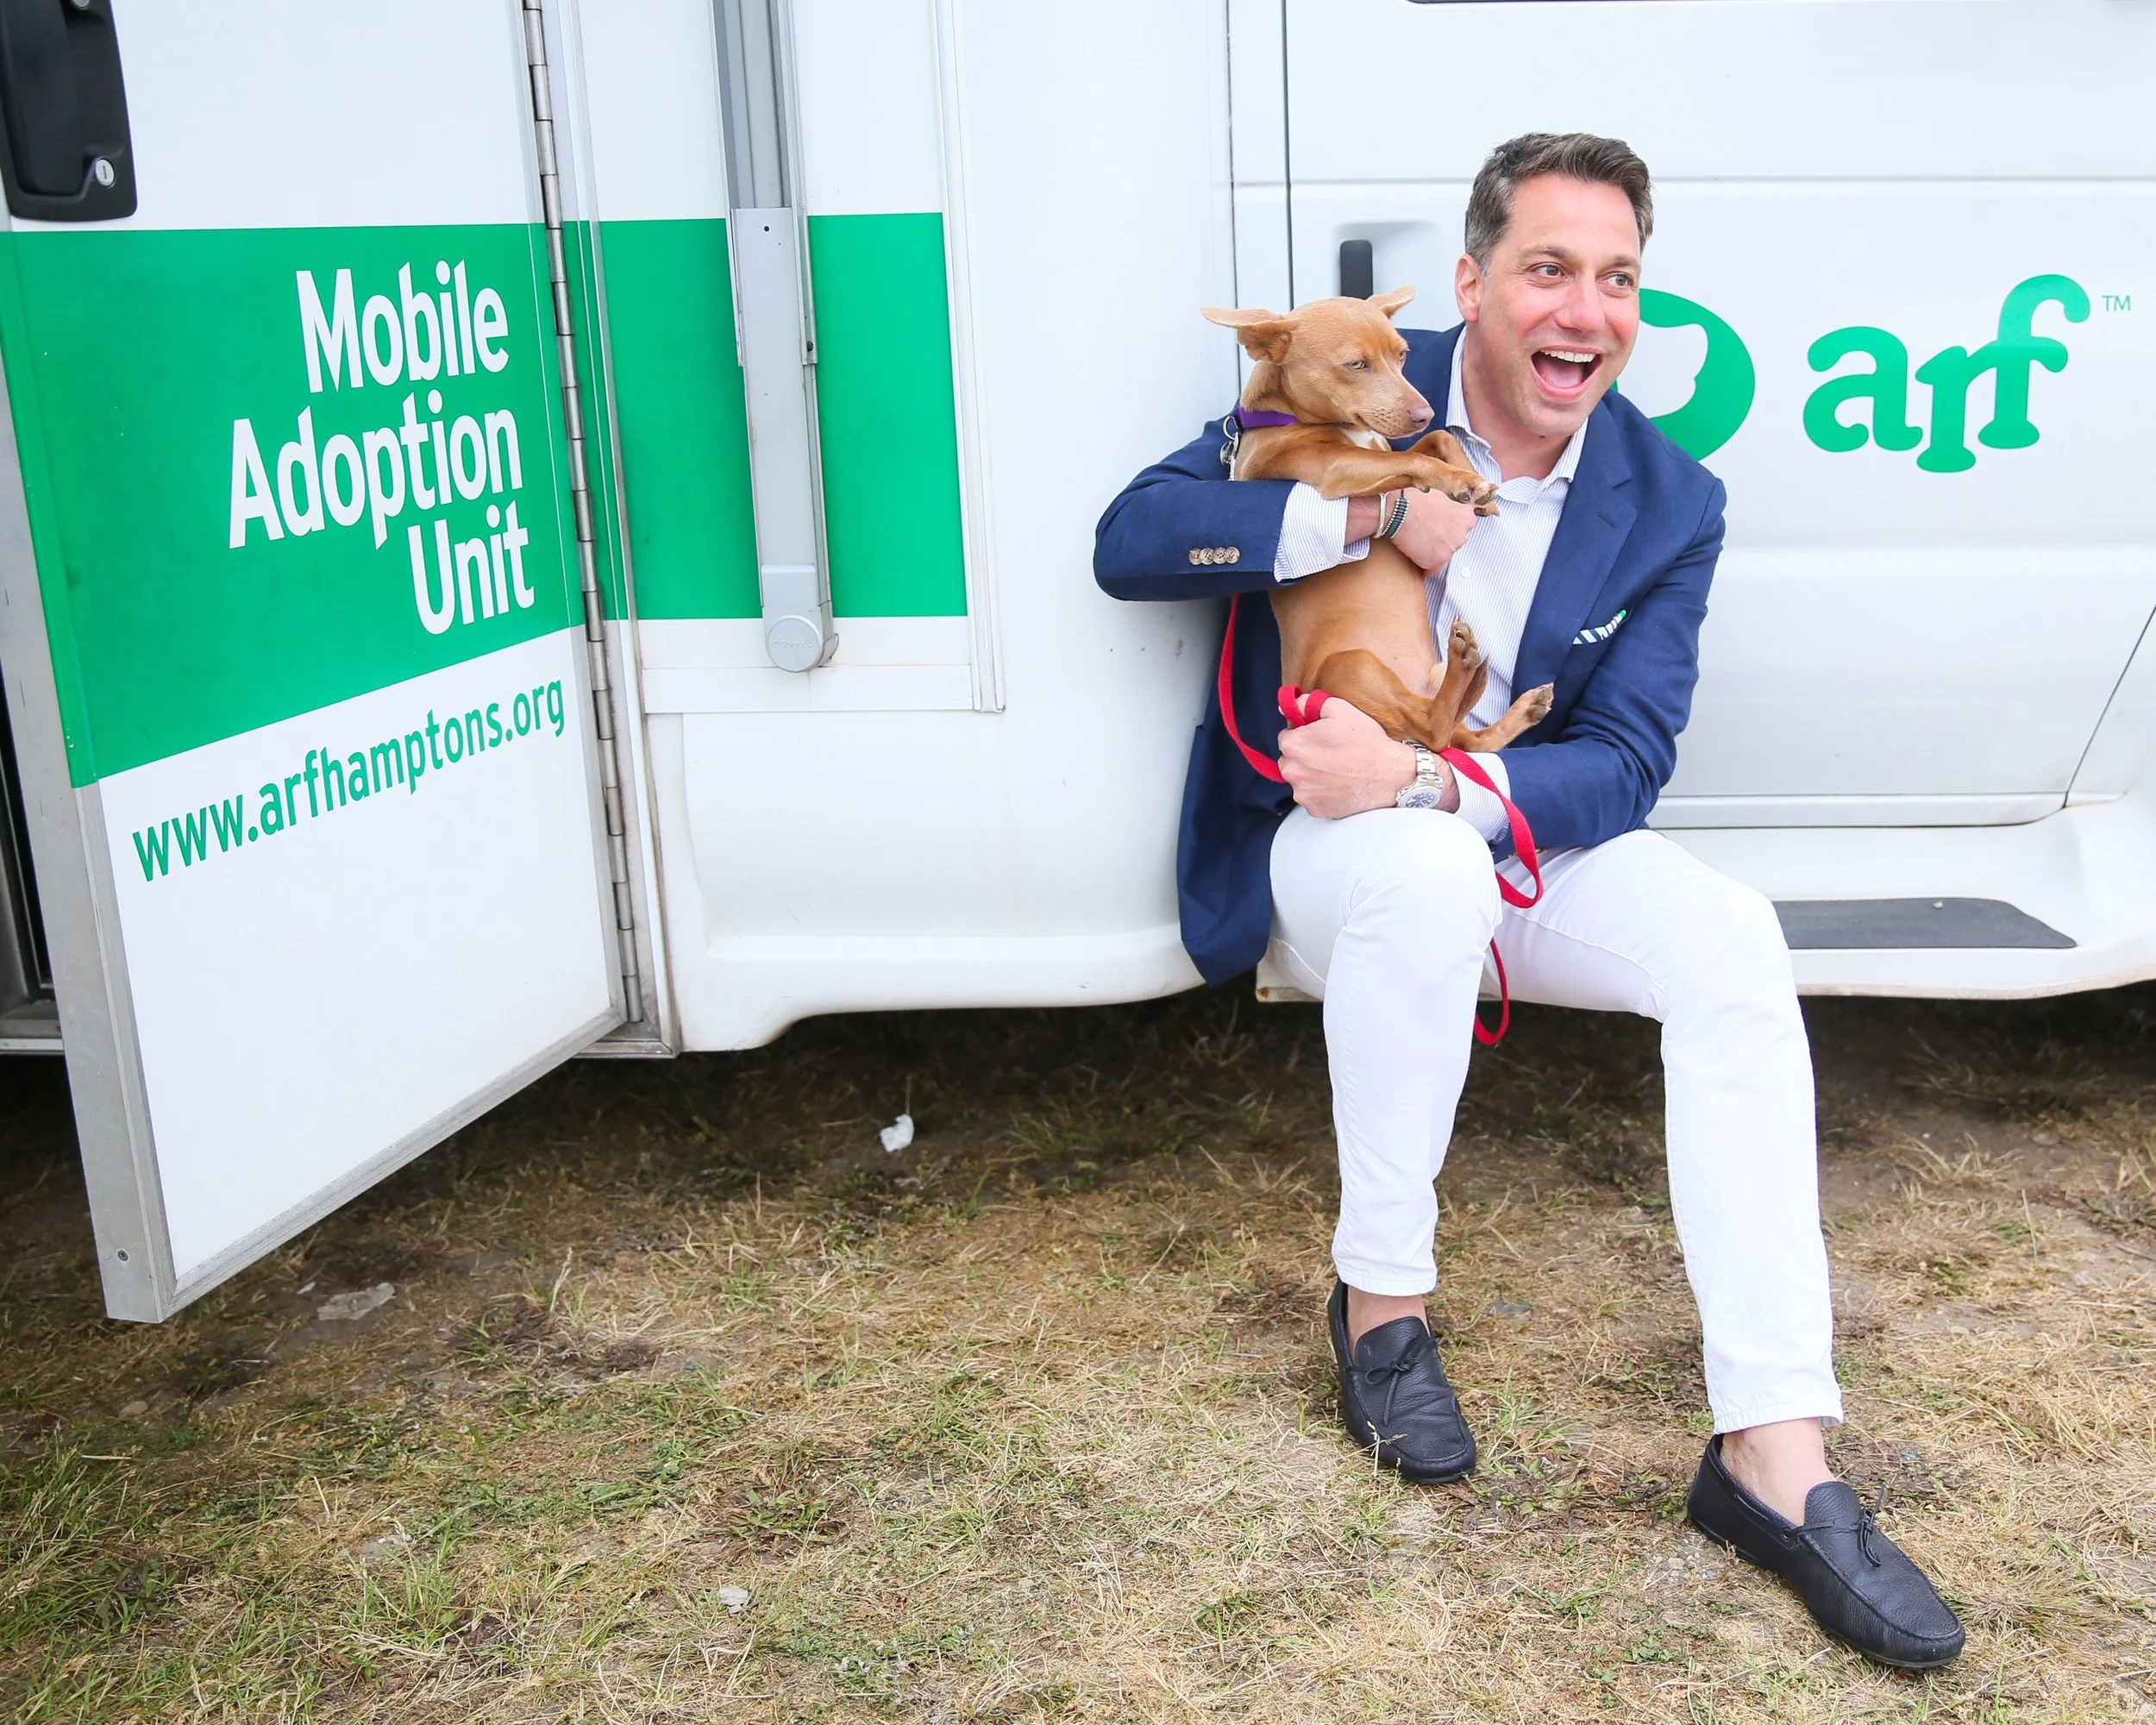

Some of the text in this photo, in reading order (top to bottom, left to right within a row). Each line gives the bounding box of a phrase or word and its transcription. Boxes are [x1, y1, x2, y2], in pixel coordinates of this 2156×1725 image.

[296, 260, 509, 393] Mobile
[1802, 273, 2132, 474] arf TM
[229, 389, 523, 549] Adoption
[407, 499, 535, 635] Unit
[132, 681, 565, 881] www.arfhamptons.org
